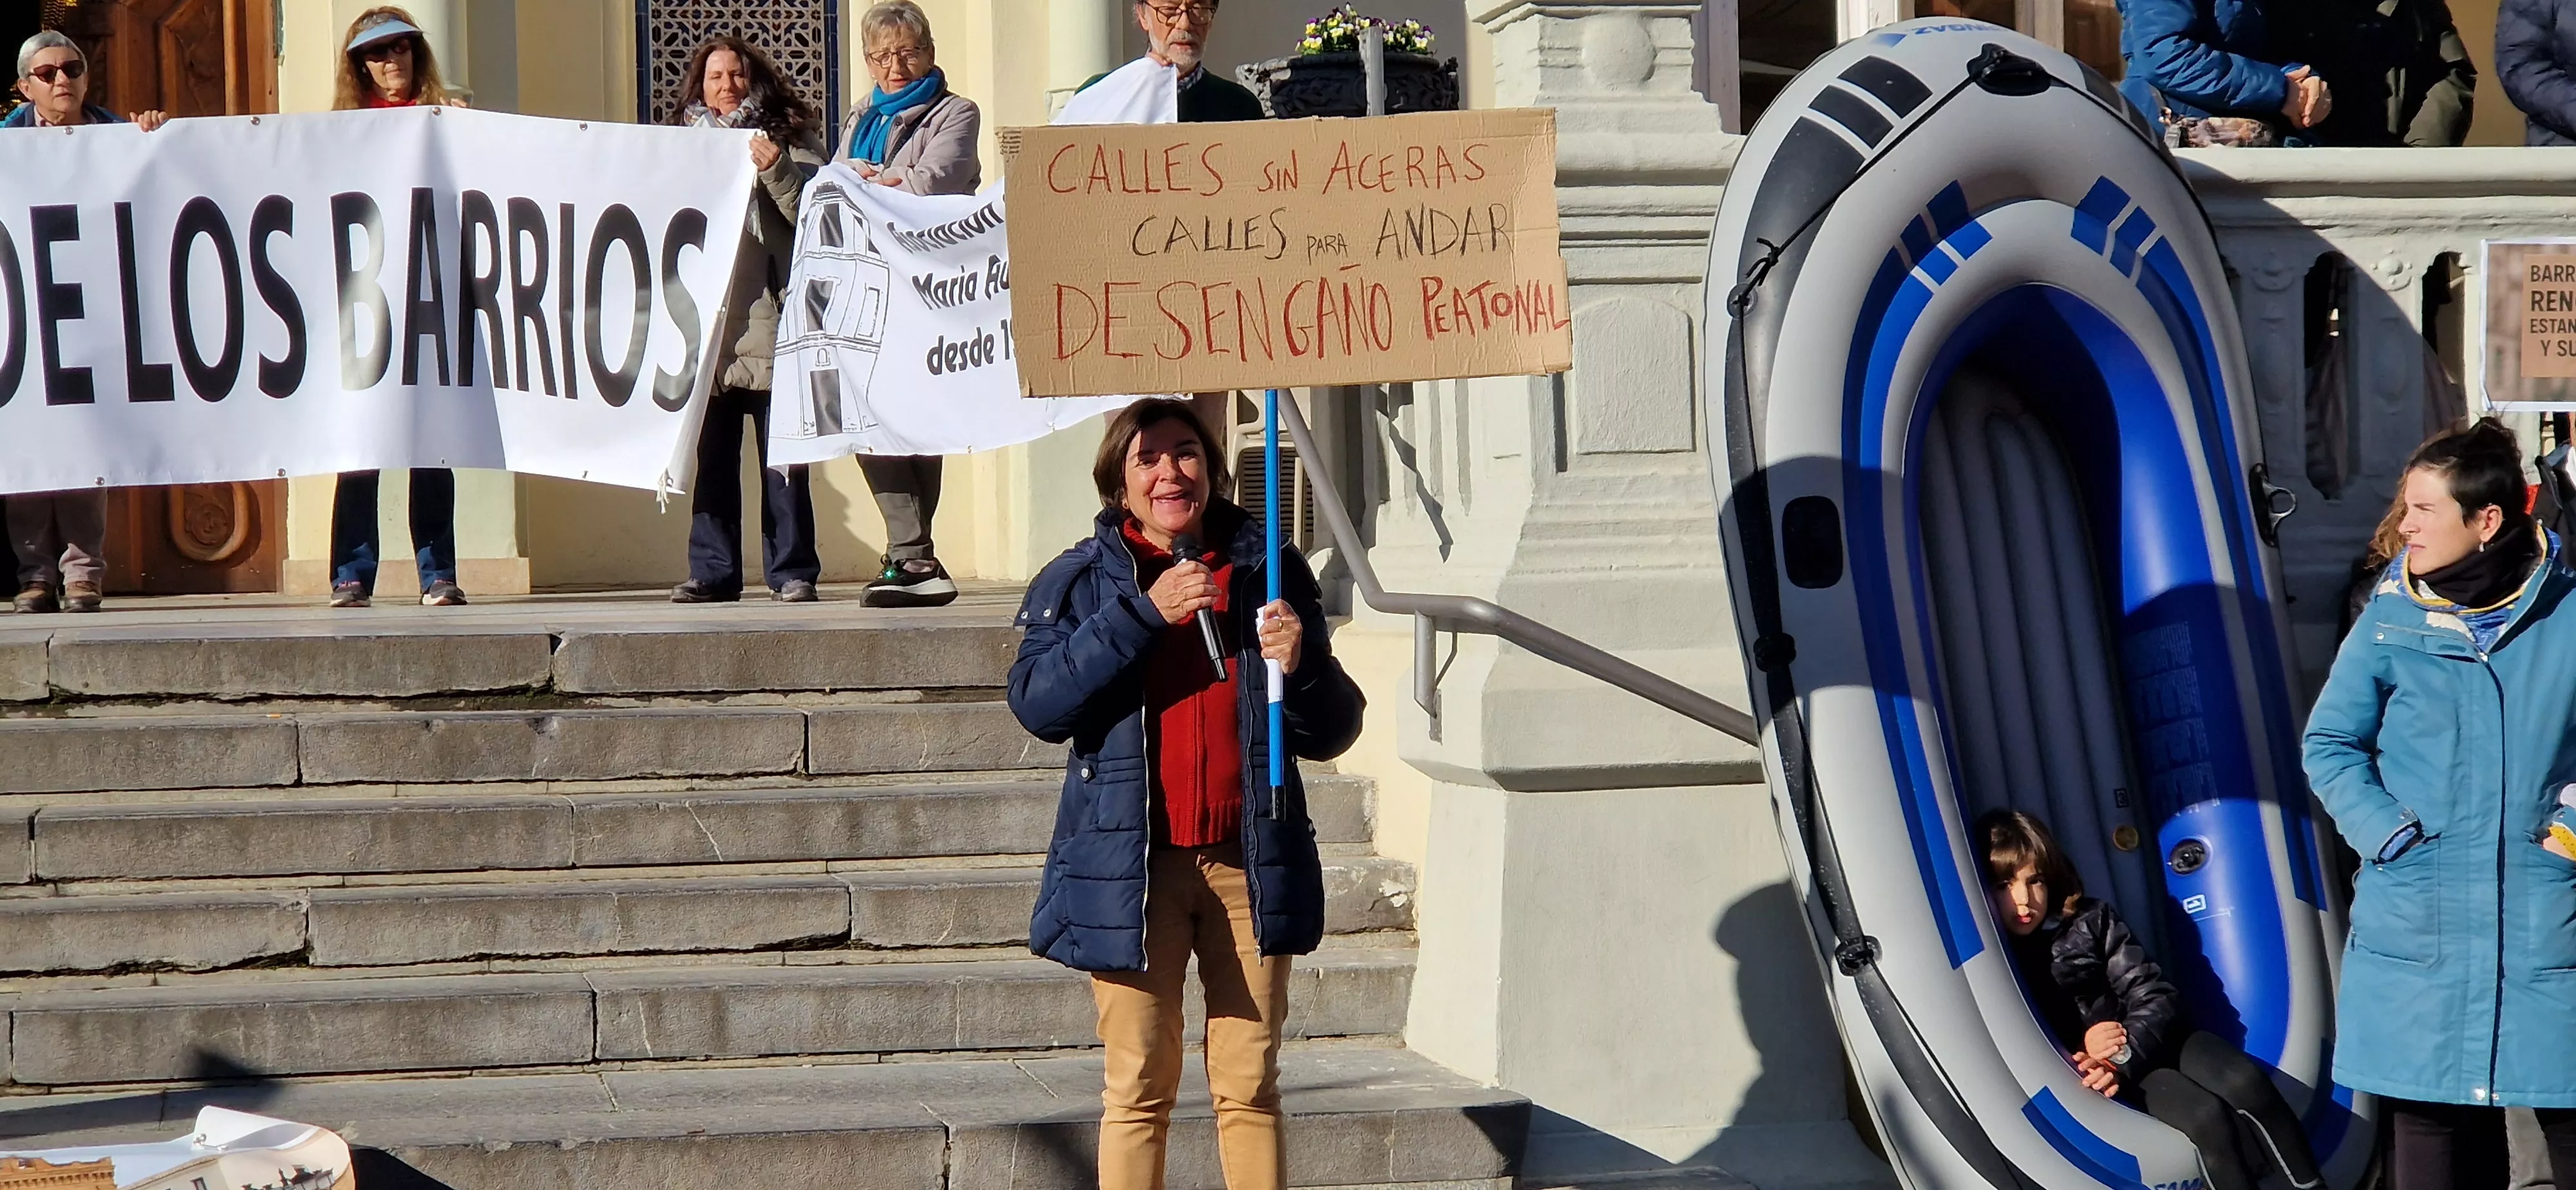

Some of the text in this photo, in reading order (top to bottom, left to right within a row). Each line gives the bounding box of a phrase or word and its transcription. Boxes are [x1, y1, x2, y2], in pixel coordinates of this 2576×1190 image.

[1047, 140, 1489, 196] CALLES SIN ACERAS
[1132, 202, 1514, 266] CALLES PARA ANDAR
[113, 193, 308, 403] LOS
[330, 186, 708, 413] BARRIOS
[1052, 263, 1392, 363] DESENGAÑO
[2530, 290, 2576, 312] REN
[926, 318, 1015, 376] desde 1
[2540, 339, 2552, 357] Y
